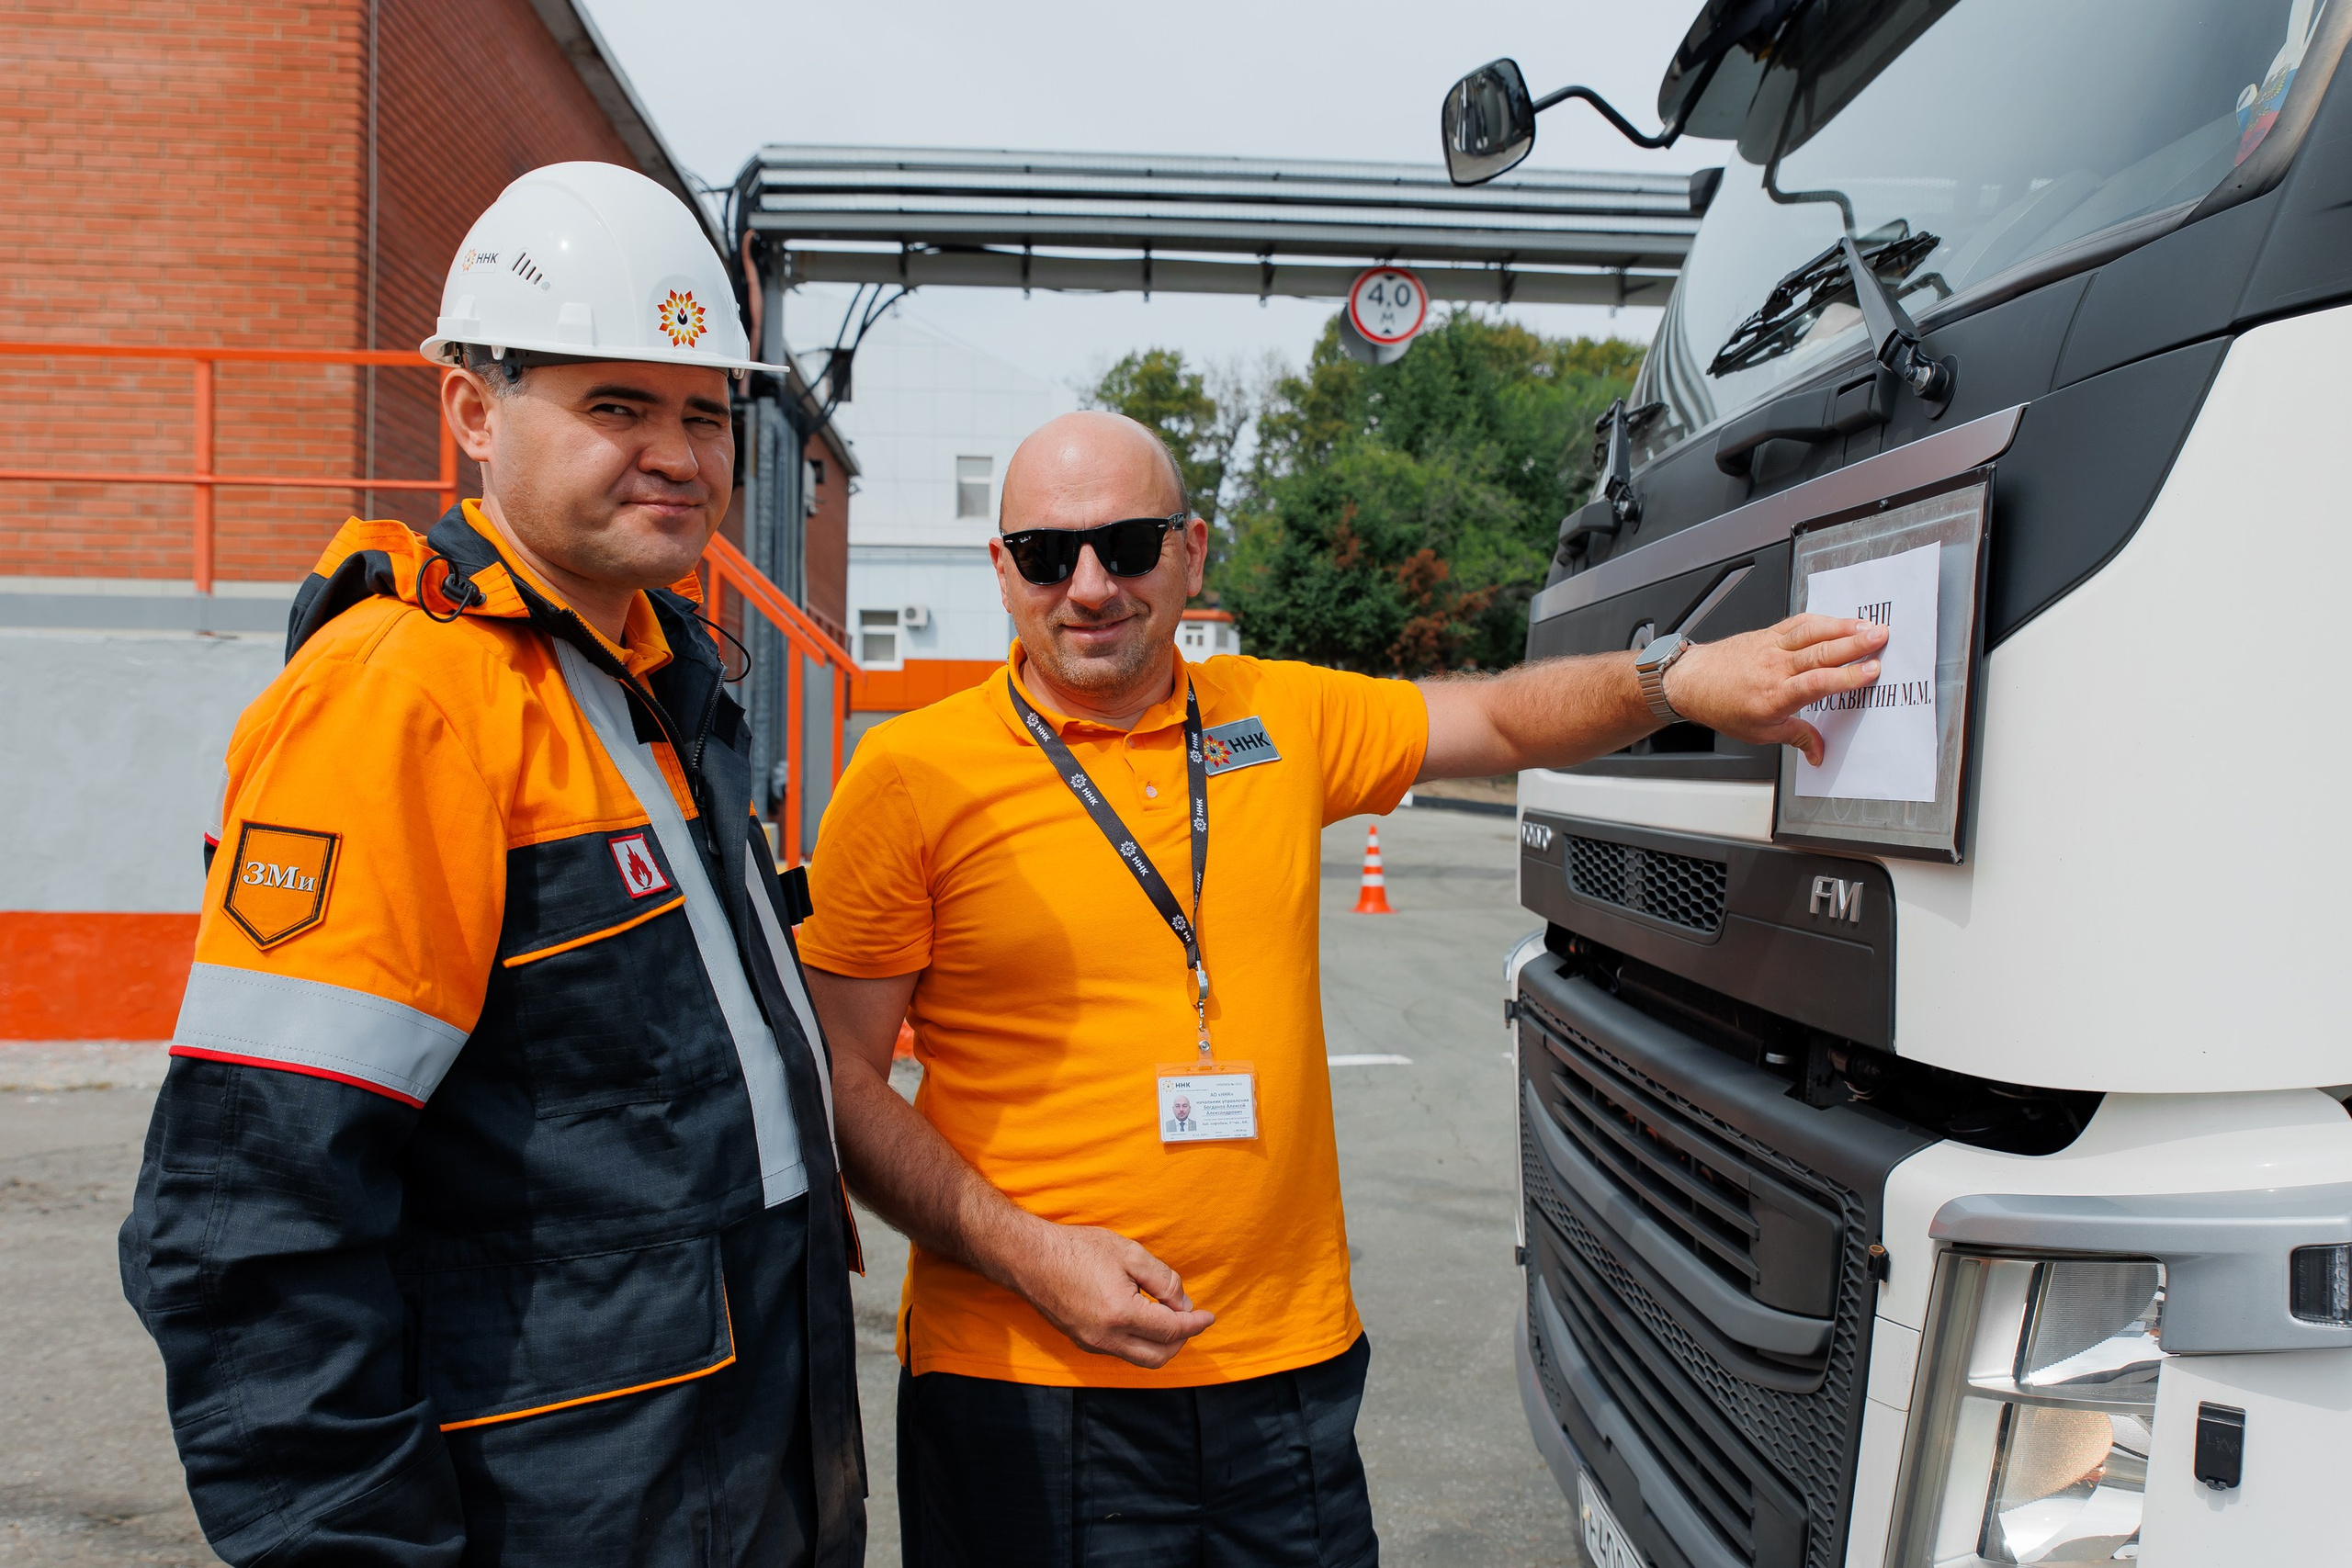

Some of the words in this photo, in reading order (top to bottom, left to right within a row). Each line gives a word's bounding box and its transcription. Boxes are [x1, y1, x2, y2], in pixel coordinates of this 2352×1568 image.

[476, 253, 500, 264] ННК
[1900, 680, 1931, 706] М.М.
[1035, 724, 1052, 743] ННК
[1227, 731, 1272, 754] ННК
[1081, 787, 1099, 807] ННК
[1195, 797, 1204, 817] ННК
[1131, 856, 1149, 876] ННК
[1809, 875, 1864, 923] FM
